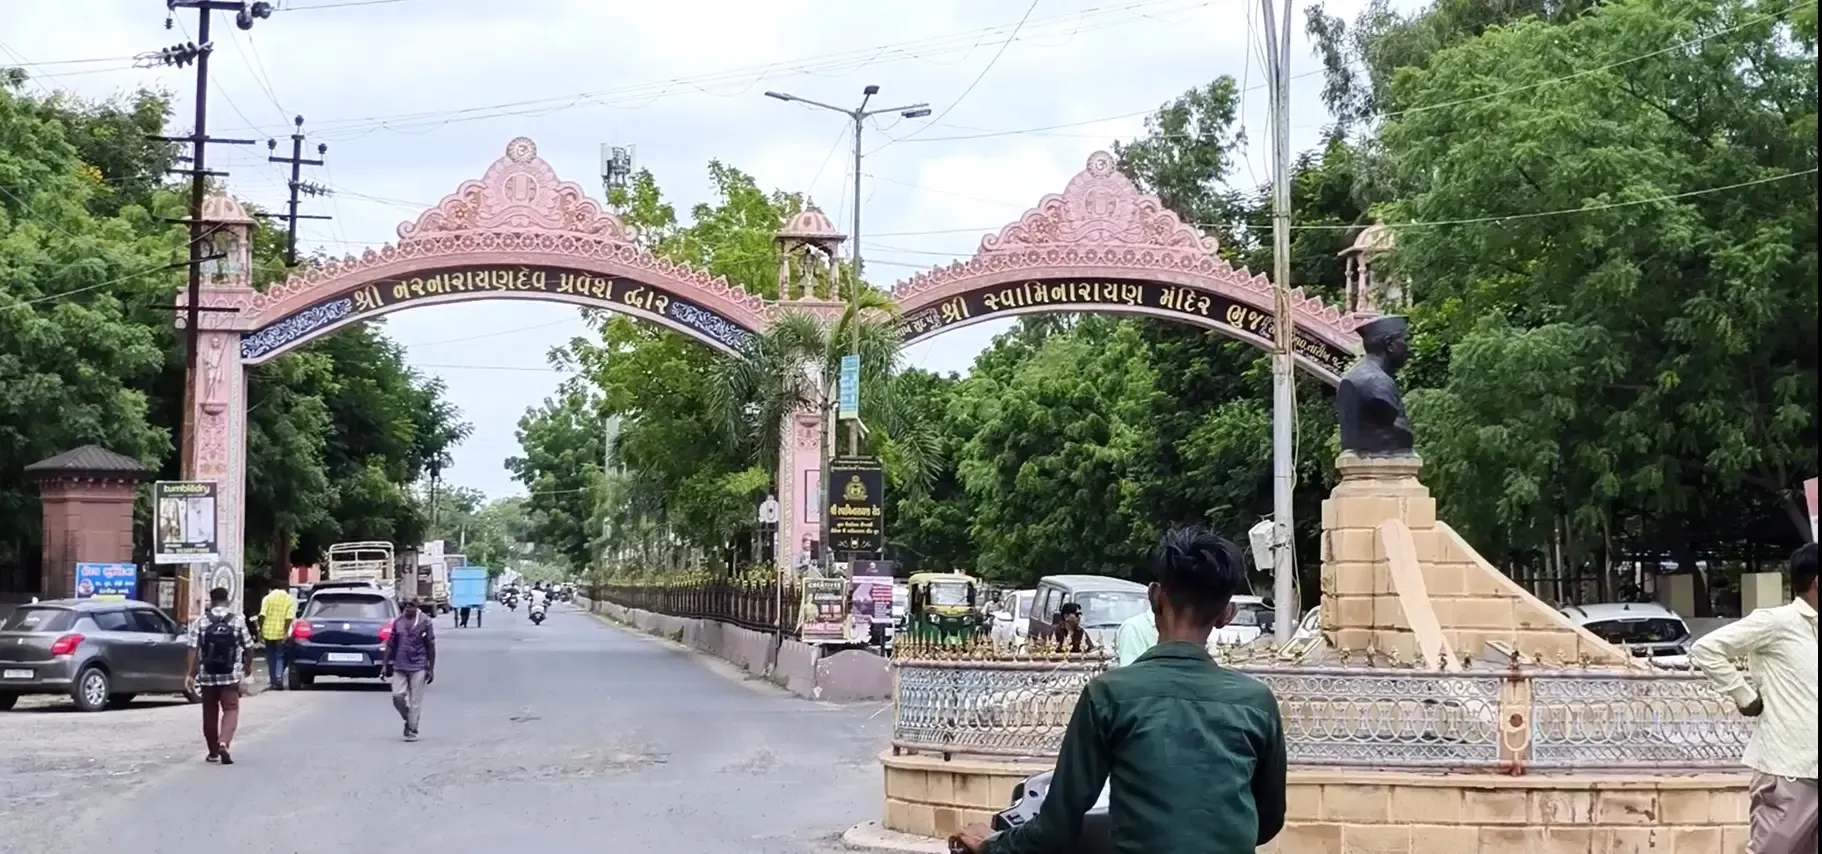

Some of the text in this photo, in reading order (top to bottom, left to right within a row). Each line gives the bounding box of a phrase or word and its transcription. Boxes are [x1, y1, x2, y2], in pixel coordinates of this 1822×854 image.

[354, 265, 670, 315] શ્રી નરનારાયણદેવ પ્રવેશ દ્વાર
[941, 296, 970, 324] શ્રી
[983, 280, 1144, 311] સ્વામિનારાયણ
[1159, 286, 1211, 315] મંદિર
[1226, 304, 1264, 330] ભુજ
